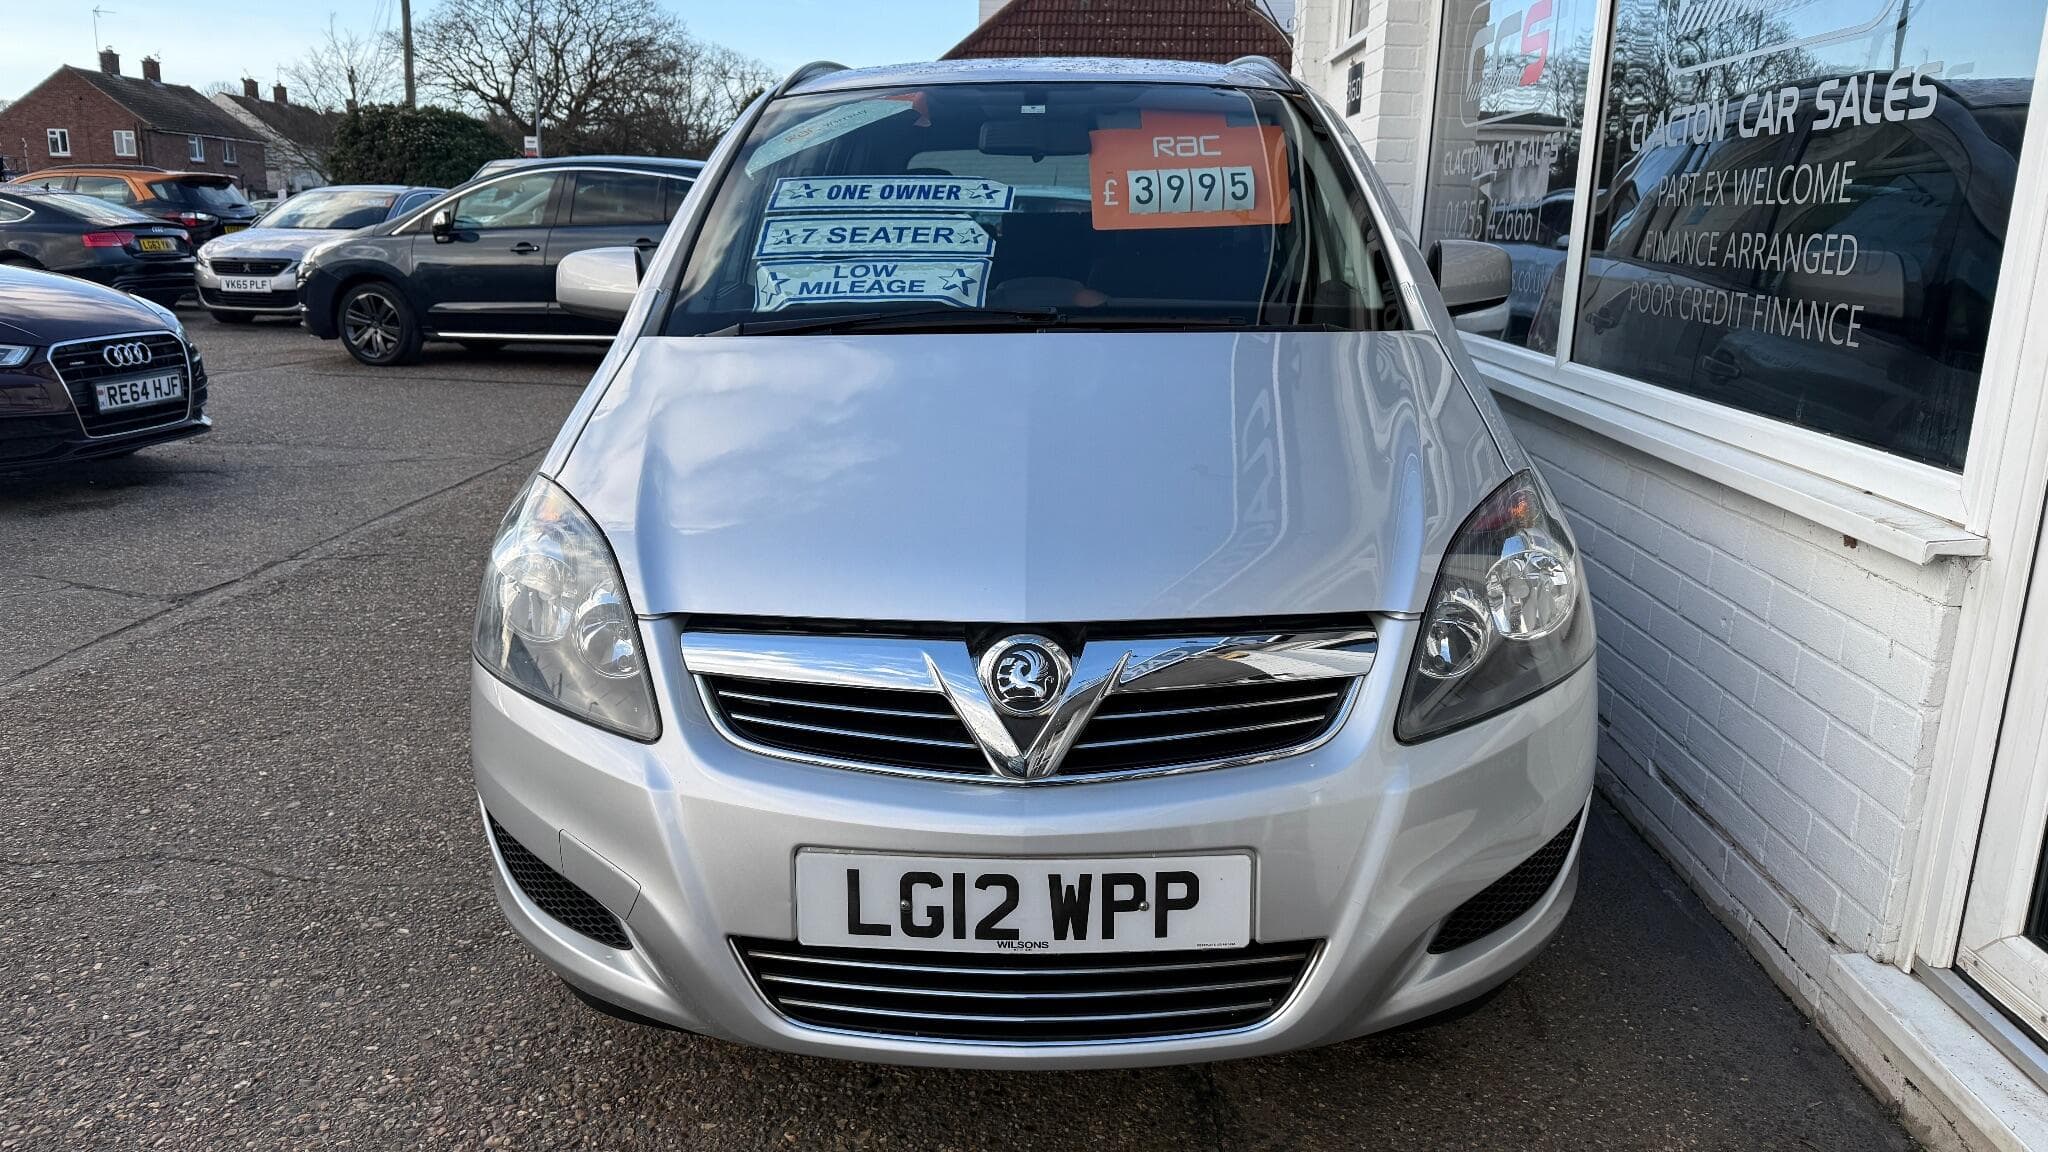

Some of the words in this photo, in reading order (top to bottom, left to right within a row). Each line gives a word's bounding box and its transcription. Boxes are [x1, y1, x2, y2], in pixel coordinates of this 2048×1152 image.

[1630, 100, 1729, 152] CLACTON
[1738, 86, 1800, 139] CAR
[1812, 61, 1944, 132] SALES
[1443, 143, 1489, 176] CLACTON
[1491, 141, 1515, 170] CAR
[1519, 132, 1561, 167] SALES
[826, 184, 873, 200] ONE
[879, 184, 962, 201] OWNER
[1103, 179, 1118, 205] £
[1134, 172, 1249, 205] 3995
[1657, 172, 1699, 208] PART
[1703, 169, 1729, 207] EX
[1733, 160, 1857, 207] WELCOME
[801, 228, 818, 244] 7
[826, 226, 955, 244] SEATER
[1444, 200, 1485, 239] 01255
[833, 264, 898, 279] LOW
[1643, 231, 1720, 266] FINANCE
[1722, 232, 1858, 276] ARRANGED
[225, 279, 248, 289] VK65
[249, 280, 268, 289] PLF
[798, 279, 926, 295] MILEAGE
[1628, 281, 1675, 318] POOR
[1679, 286, 1748, 328] CREDIT
[1751, 294, 1865, 348] FINANCE
[106, 380, 150, 406] RE64
[153, 376, 179, 399] HJF
[846, 868, 1020, 941] LG12
[1048, 870, 1200, 941] WPP
